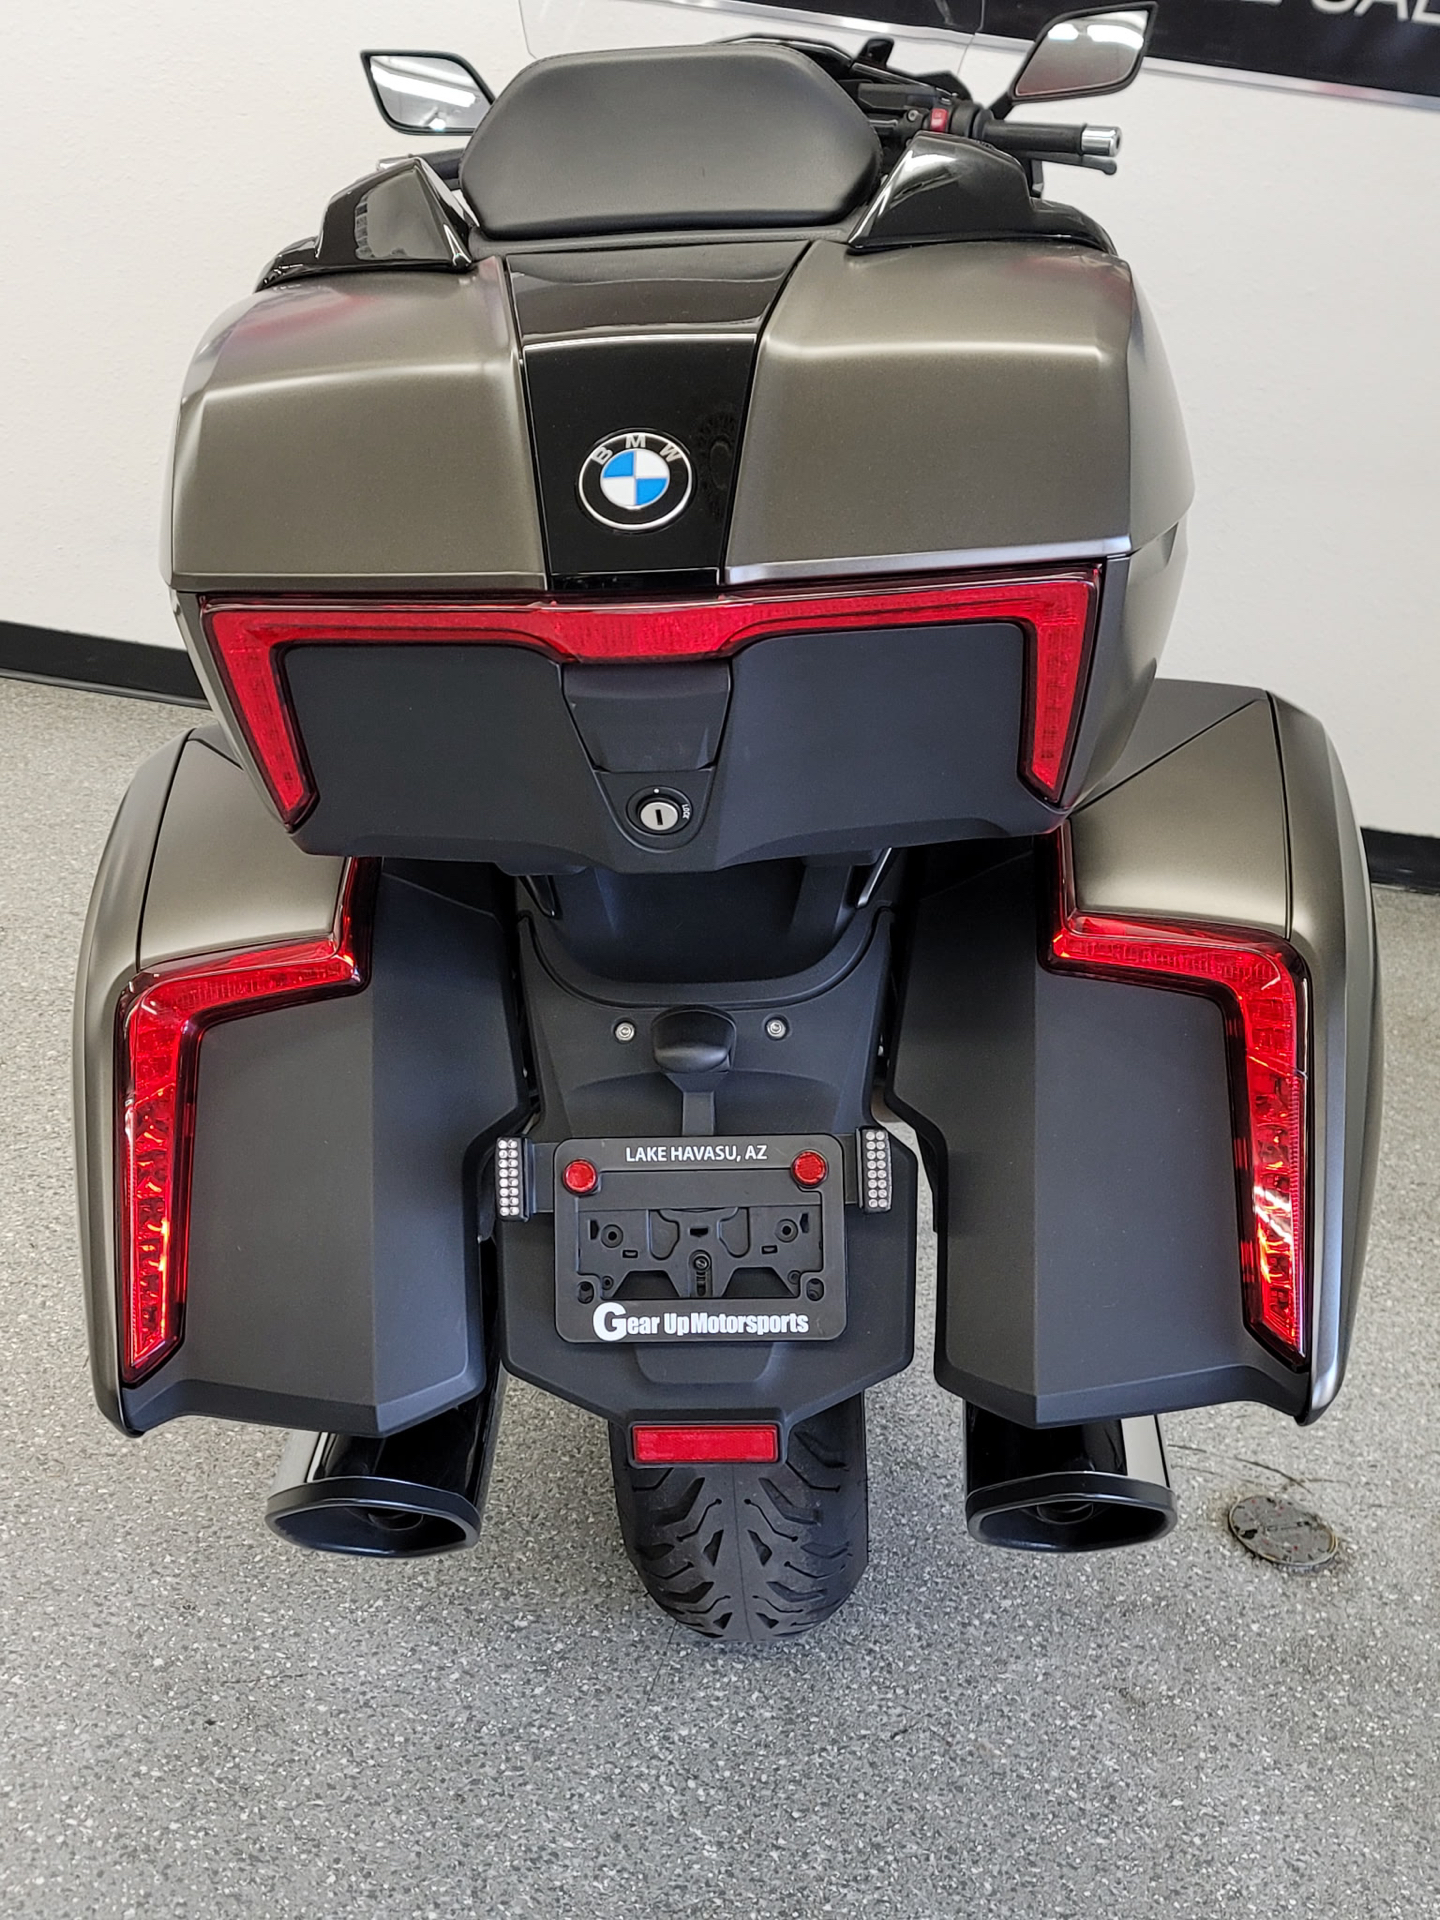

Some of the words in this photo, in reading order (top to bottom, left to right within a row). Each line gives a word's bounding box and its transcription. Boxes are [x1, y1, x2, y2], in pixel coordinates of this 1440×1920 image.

[591, 434, 682, 465] BMW
[681, 803, 691, 820] LOCK
[625, 1146, 667, 1162] LAKE
[670, 1145, 741, 1163] HAVASU,
[744, 1144, 768, 1160] AZ
[592, 1301, 660, 1342] Gear
